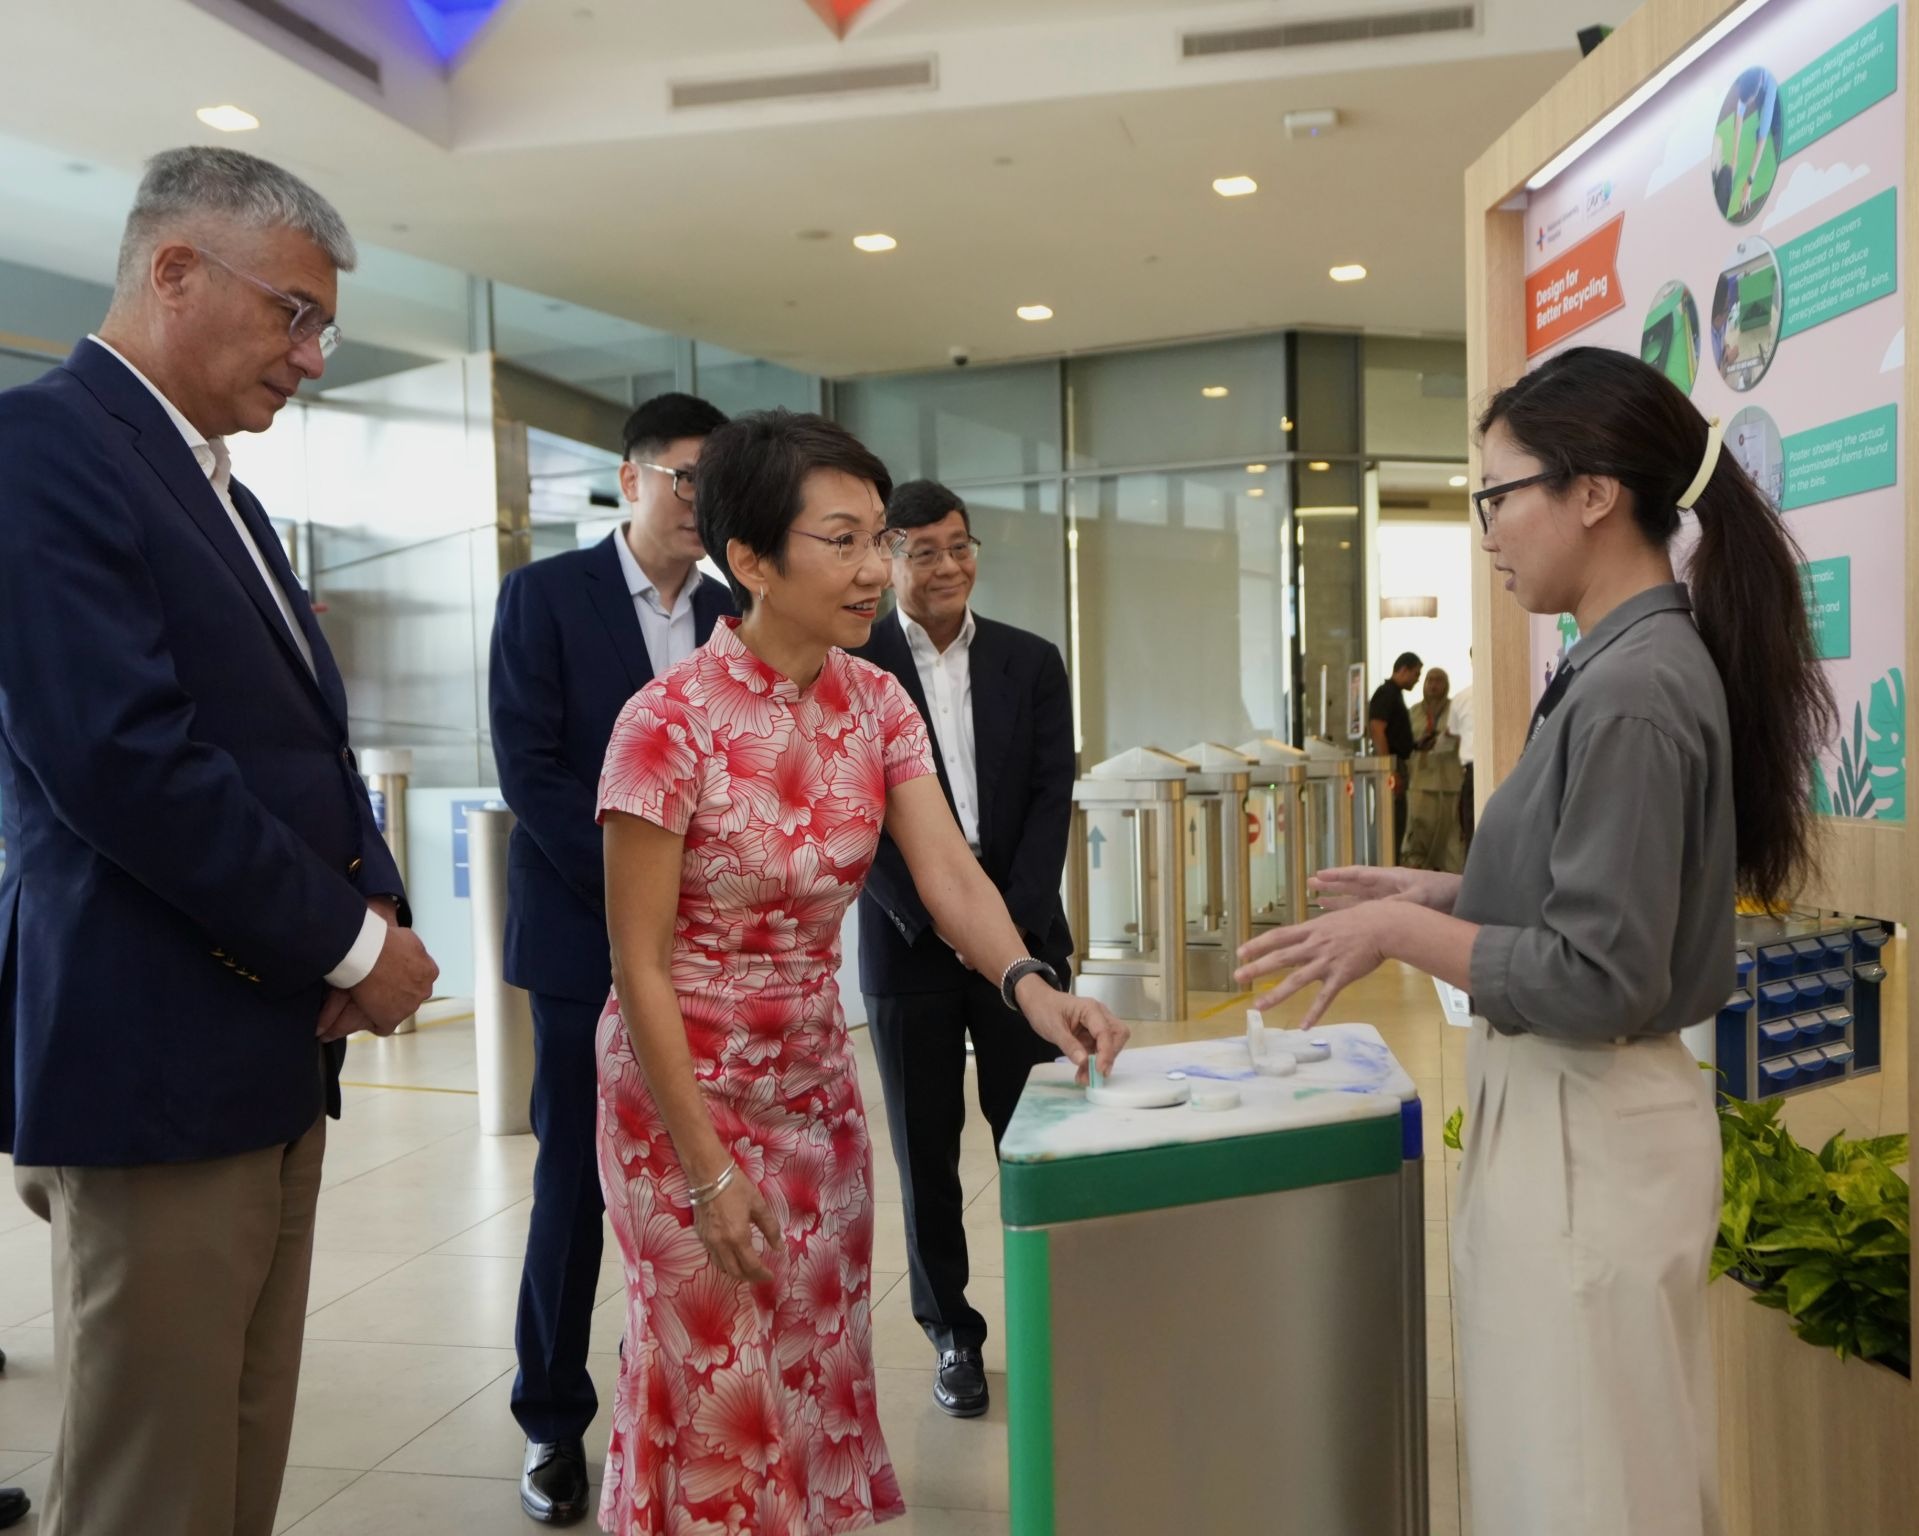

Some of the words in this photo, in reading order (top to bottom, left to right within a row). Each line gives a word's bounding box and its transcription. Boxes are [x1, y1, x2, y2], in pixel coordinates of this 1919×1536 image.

[1788, 82, 1800, 97] The
[1860, 27, 1877, 48] and
[1789, 249, 1801, 261] The
[1802, 231, 1835, 254] modified
[1836, 218, 1861, 238] covers
[1788, 266, 1830, 292] mechanism
[1832, 262, 1840, 273] to
[1841, 248, 1869, 267] reduce
[1789, 249, 1827, 277] introduced
[1537, 278, 1565, 307] Design
[1566, 269, 1579, 289] for
[1537, 303, 1561, 329] Better
[1563, 276, 1607, 313] Recycling
[1788, 296, 1800, 308] the
[1801, 287, 1819, 303] ease
[1820, 281, 1829, 294] of
[1829, 265, 1867, 290] disposing
[1789, 448, 1811, 462] Poster
[1812, 439, 1842, 456] showing
[1844, 435, 1857, 447] the
[1858, 426, 1884, 442] actual
[1789, 454, 1840, 478] contaminated
[1841, 450, 1863, 463] items
[1864, 440, 1888, 457] found
[1797, 480, 1809, 491] the
[1825, 600, 1840, 613] and
